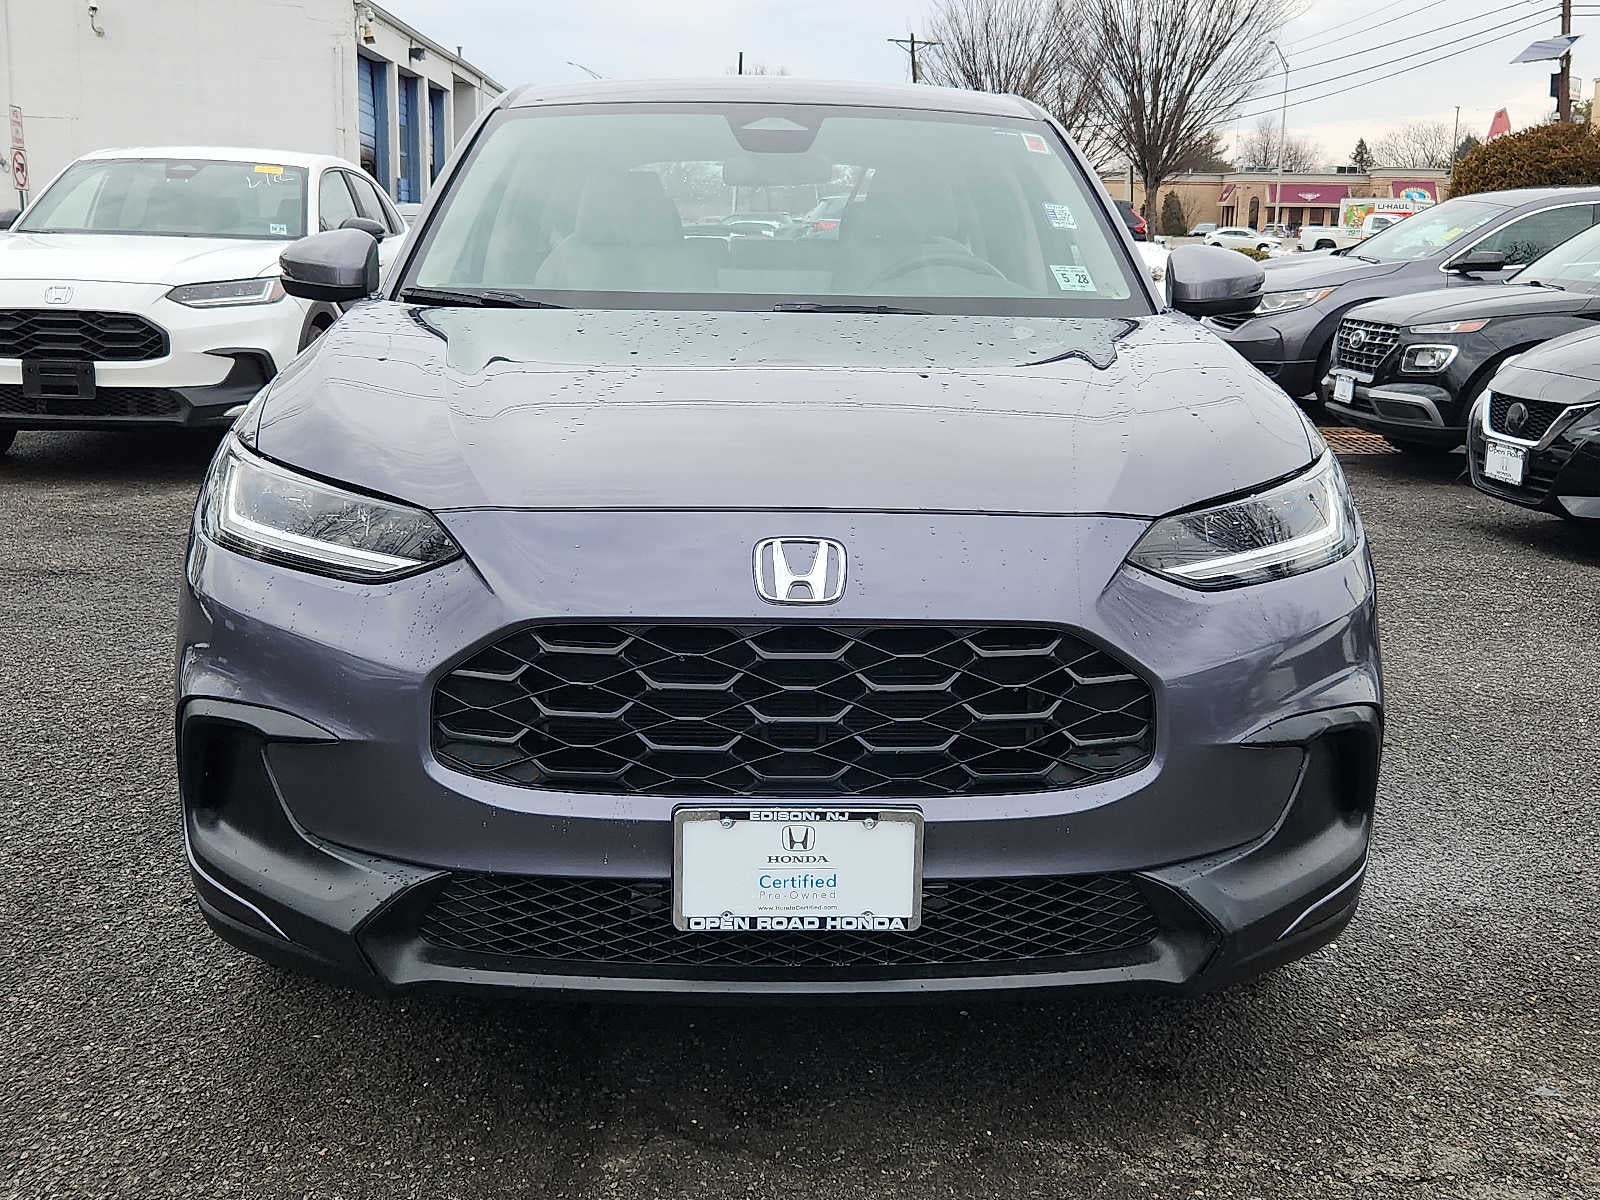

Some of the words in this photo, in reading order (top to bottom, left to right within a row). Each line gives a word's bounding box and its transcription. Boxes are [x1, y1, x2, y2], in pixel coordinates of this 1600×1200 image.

[1377, 202, 1410, 210] U-HAUL
[1061, 273, 1070, 283] 5
[1075, 273, 1089, 284] 28
[749, 811, 821, 821] EDISON,
[826, 811, 849, 821] NJ
[766, 855, 830, 864] HONDA
[759, 874, 837, 889] Certified
[759, 890, 836, 900] Pre-Owned
[689, 916, 750, 930] OPEN
[756, 916, 820, 930] ROAD
[825, 916, 906, 930] HONDA
